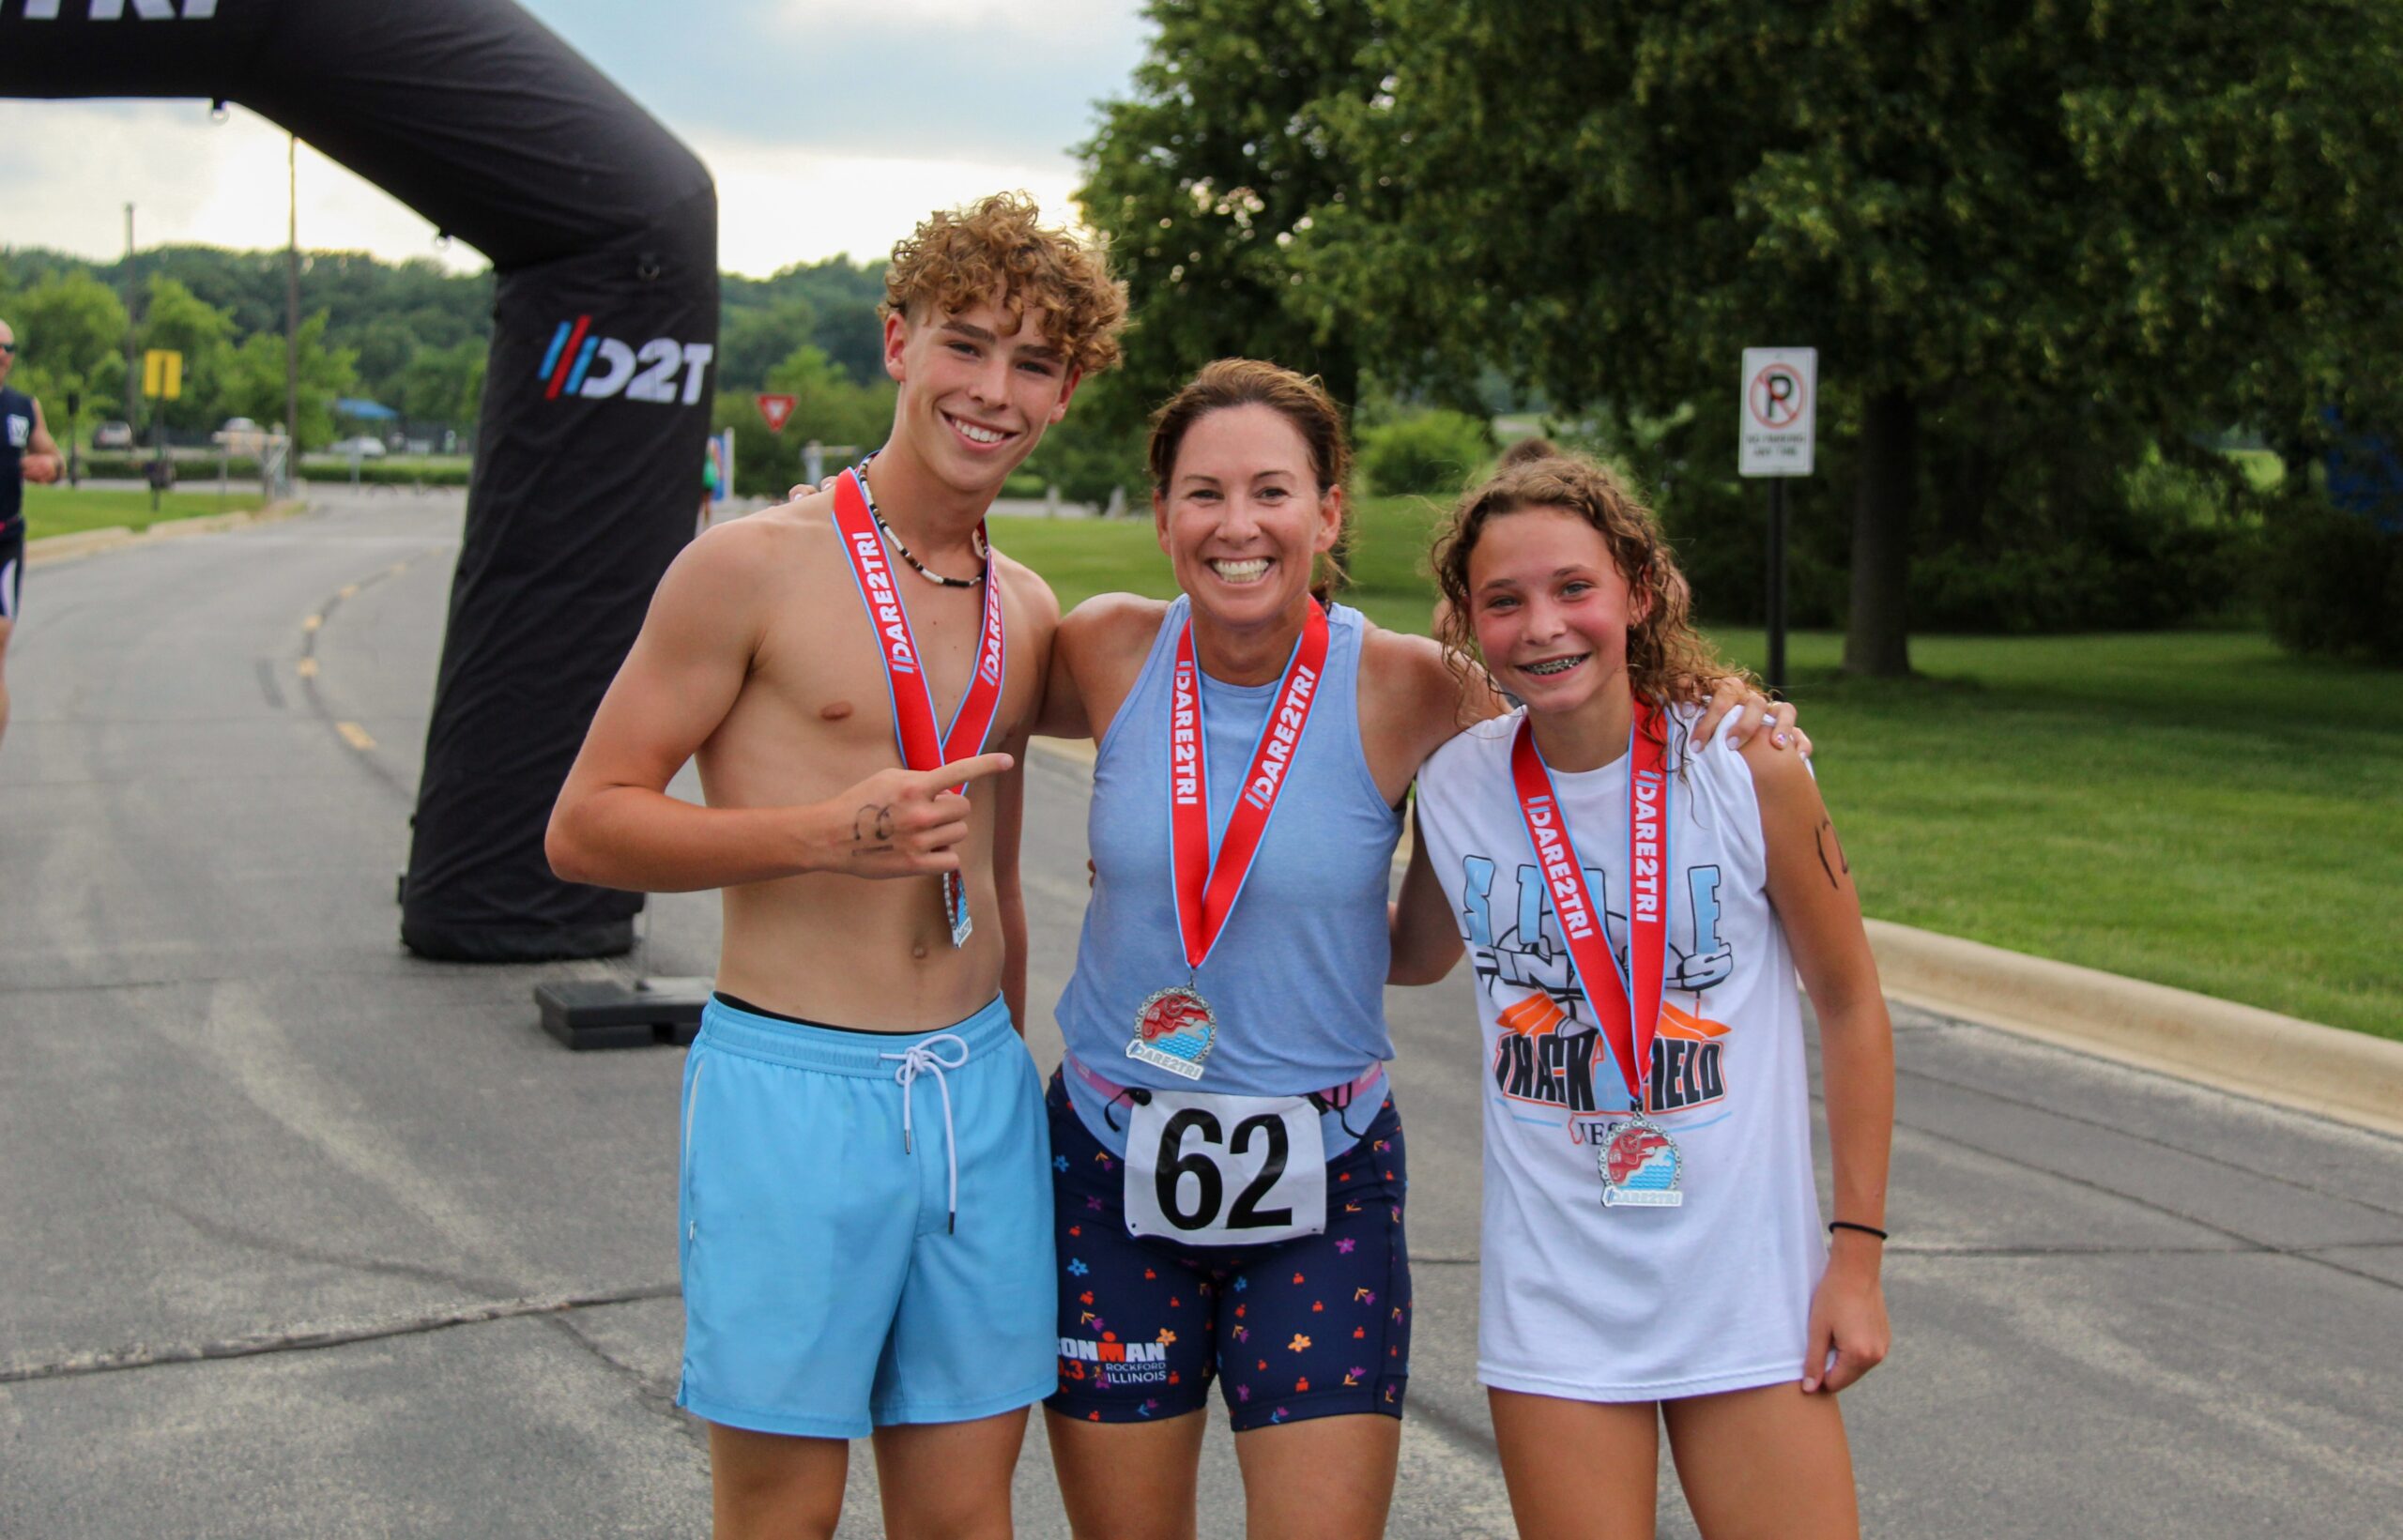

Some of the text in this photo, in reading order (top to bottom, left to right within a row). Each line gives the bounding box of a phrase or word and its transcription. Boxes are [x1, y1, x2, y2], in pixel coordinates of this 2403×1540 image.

[565, 335, 714, 406] D2T
[1767, 374, 1792, 419] P
[852, 531, 915, 665] DARE2TRI
[1174, 670, 1198, 805] DARE2TRI
[1251, 664, 1316, 803] DARE2TRI
[1528, 806, 1594, 939] DARE2TRI
[1636, 780, 1659, 922] DARE2TRI
[1133, 1042, 1201, 1078] DARE2TRI
[1630, 1037, 1725, 1111] IELD
[1156, 1108, 1293, 1230] 62
[1057, 1331, 1166, 1363] ONMAN
[1106, 1362, 1167, 1371] ROCKFORD
[1108, 1371, 1167, 1384] ILLINOIS
